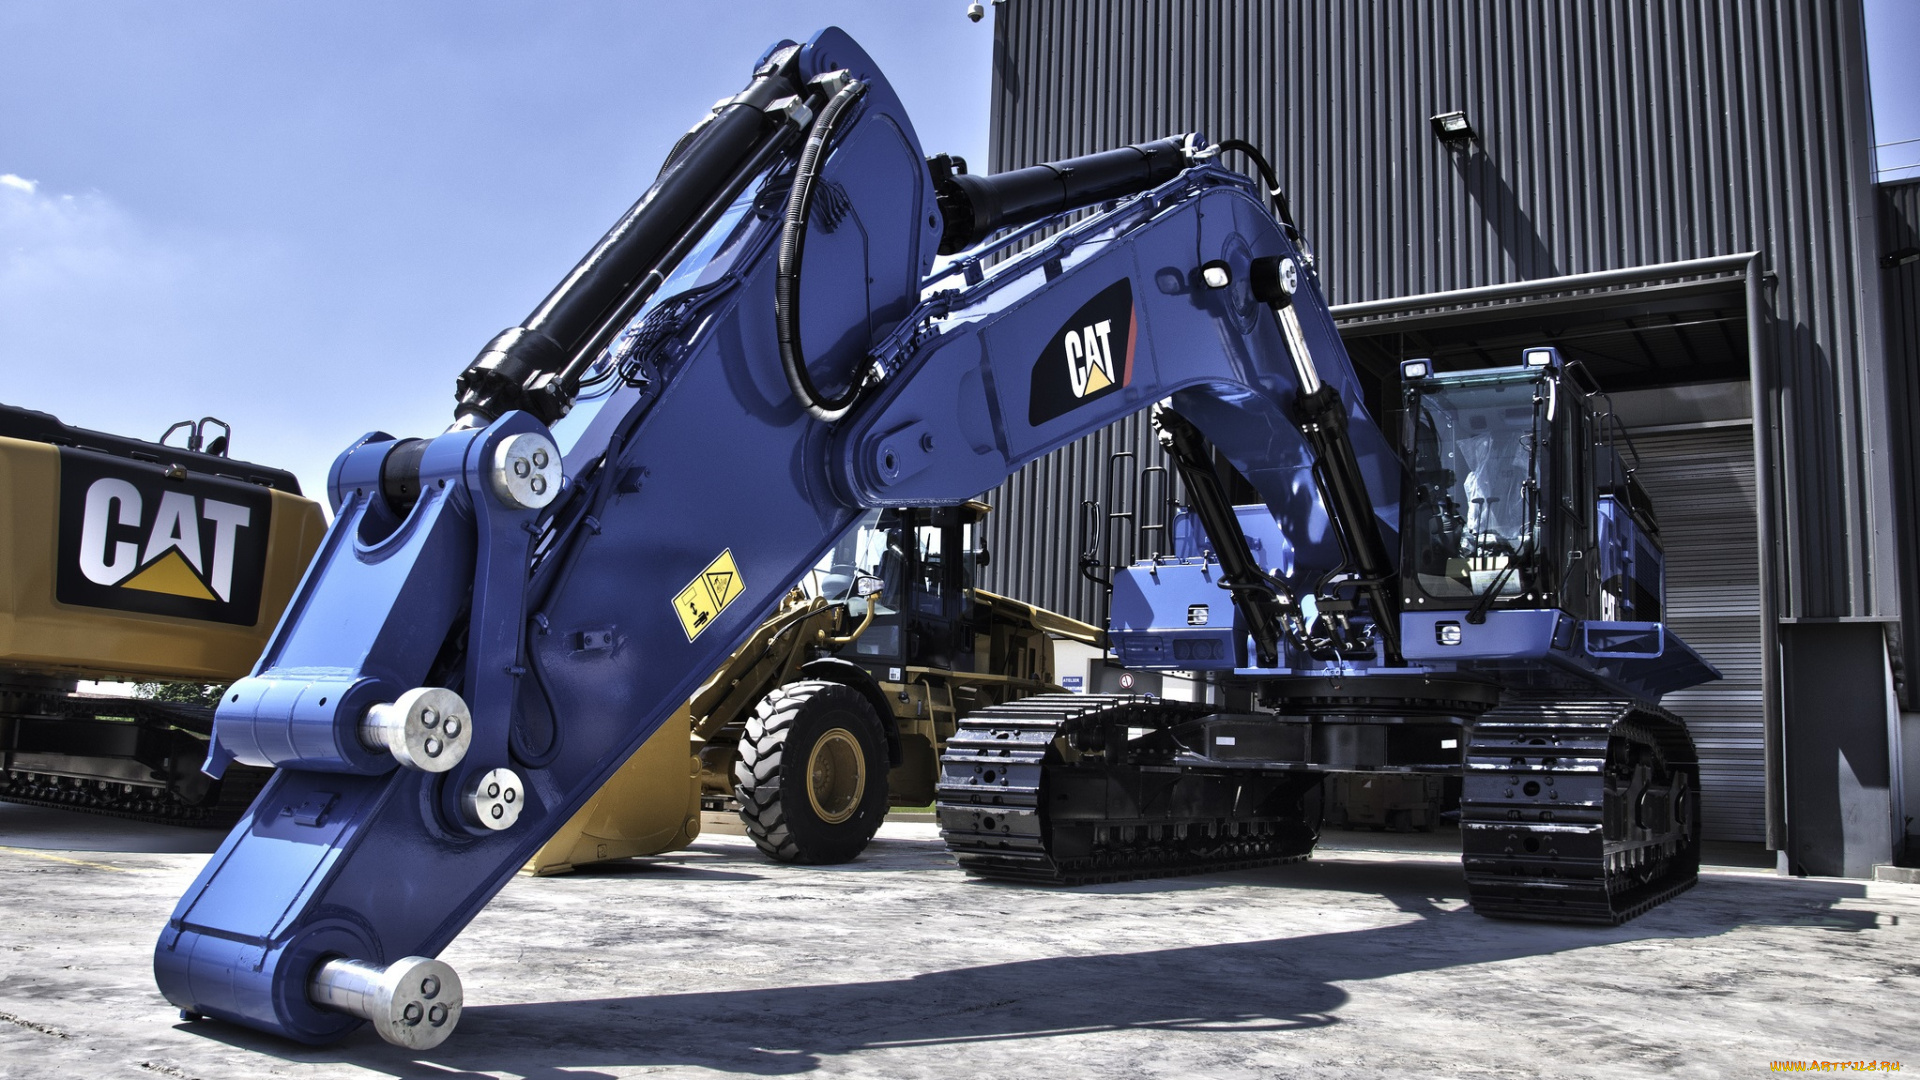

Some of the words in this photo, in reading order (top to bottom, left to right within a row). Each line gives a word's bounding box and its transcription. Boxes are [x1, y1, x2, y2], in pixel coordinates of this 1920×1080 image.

[1064, 319, 1116, 398] CAT
[79, 477, 251, 603] CAT
[1601, 589, 1616, 622] CAT
